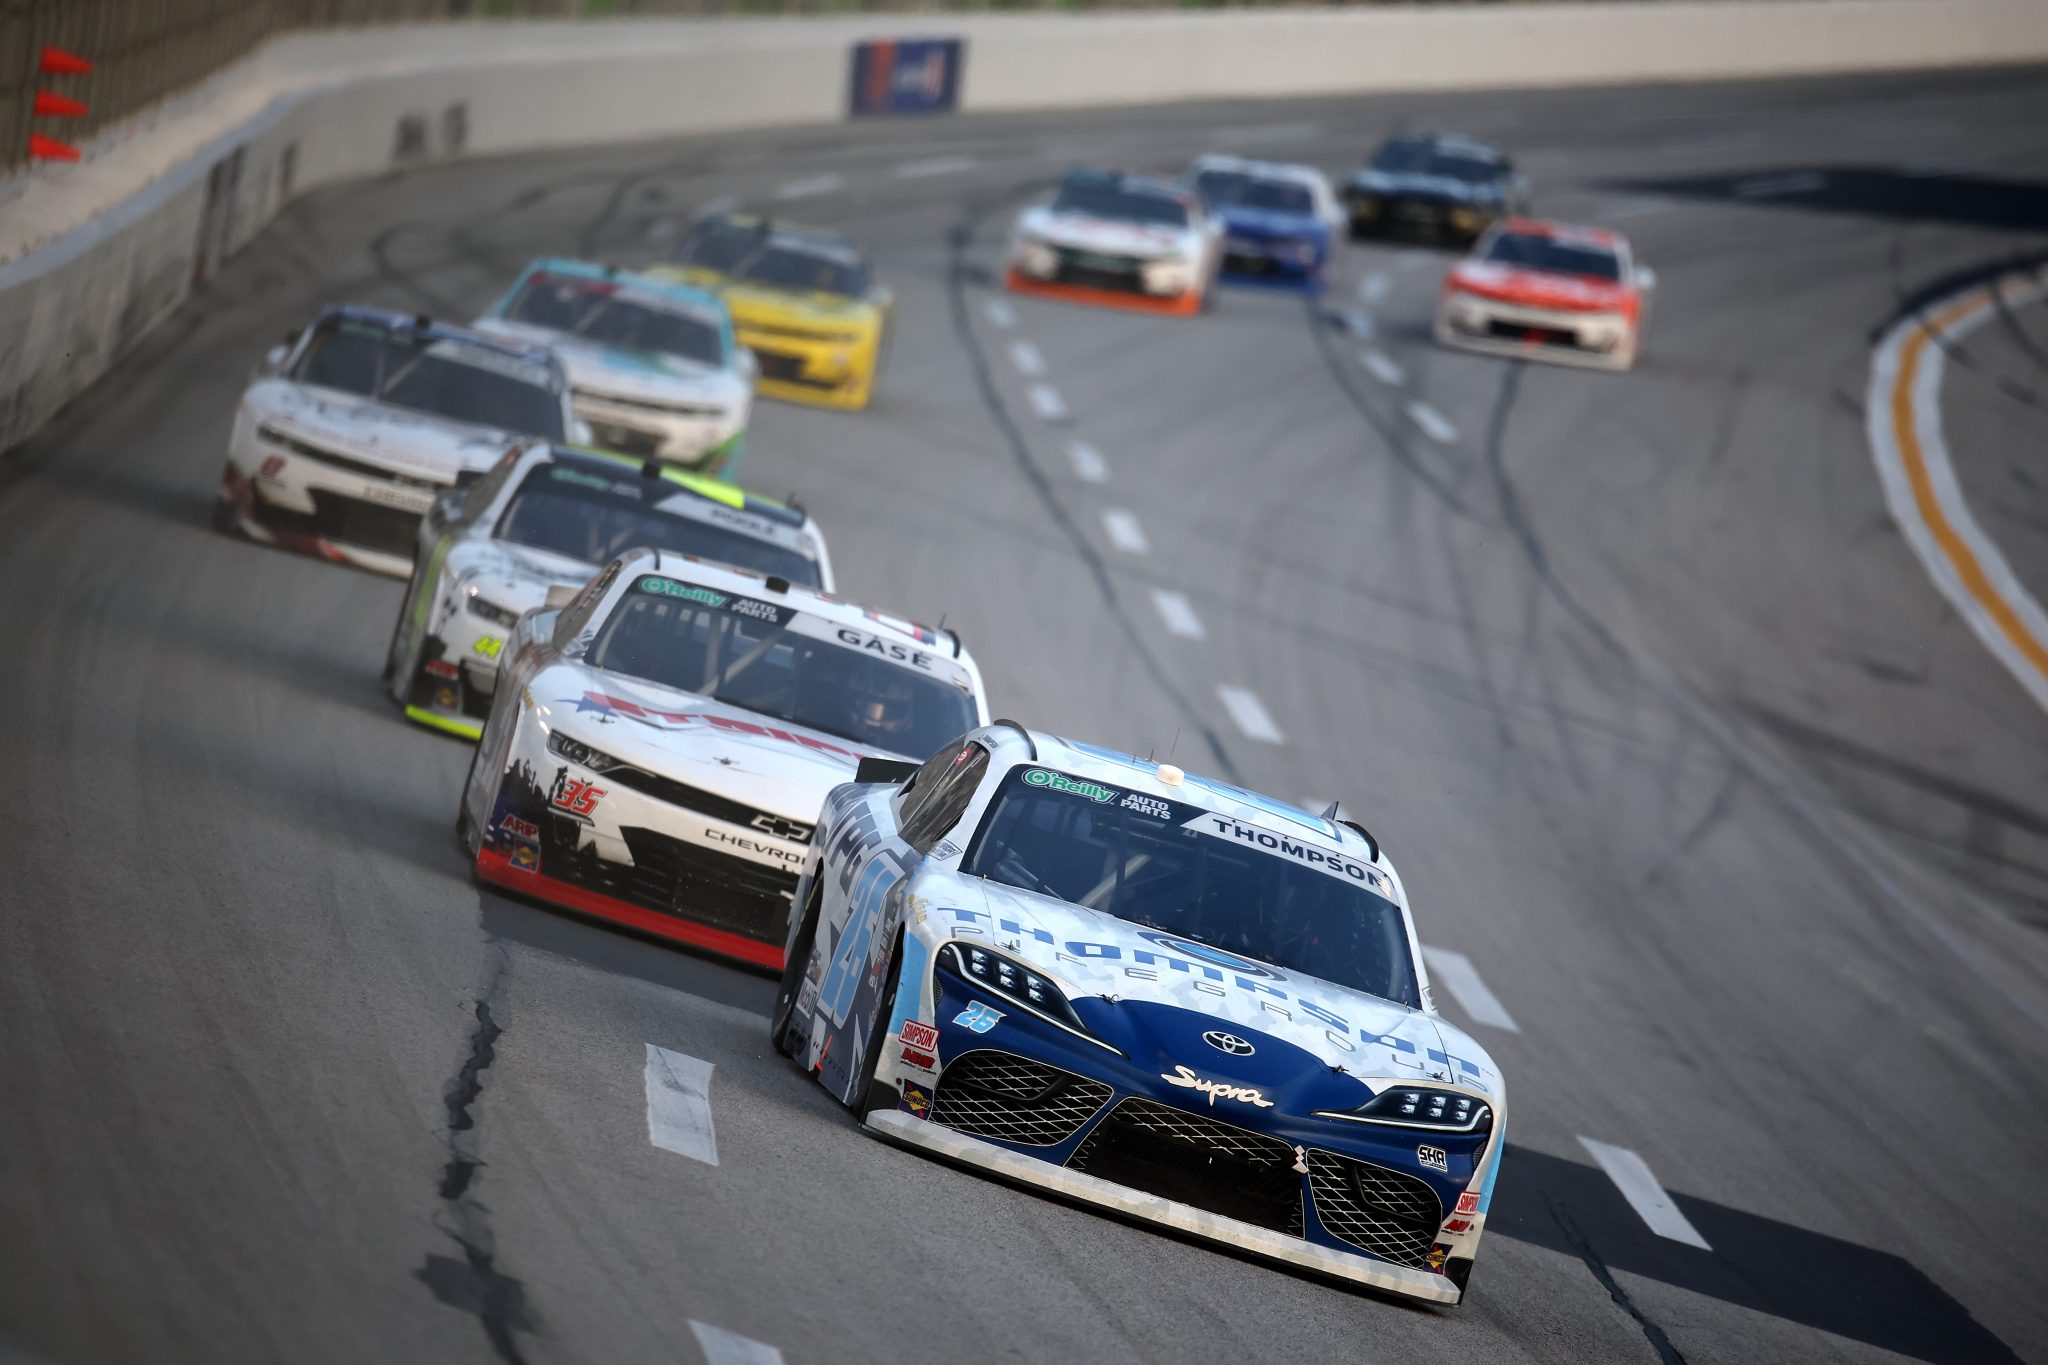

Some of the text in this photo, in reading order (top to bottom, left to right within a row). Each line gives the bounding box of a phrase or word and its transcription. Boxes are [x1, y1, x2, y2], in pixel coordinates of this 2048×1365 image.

[641, 576, 724, 606] O'Reilly
[730, 604, 780, 623] PARTS
[736, 599, 777, 615] AUTO
[474, 634, 503, 658] 44
[837, 628, 933, 671] GASE
[552, 778, 606, 816] 35
[1022, 768, 1118, 803] O'Reilly
[1119, 798, 1172, 821] PARTS
[1126, 793, 1170, 811] AUTO
[502, 814, 539, 838] ARP
[952, 999, 1007, 1034] 26
[902, 1022, 936, 1049] SIMPSON
[1160, 1064, 1275, 1108] Supra
[902, 1091, 932, 1110] SUNOCO
